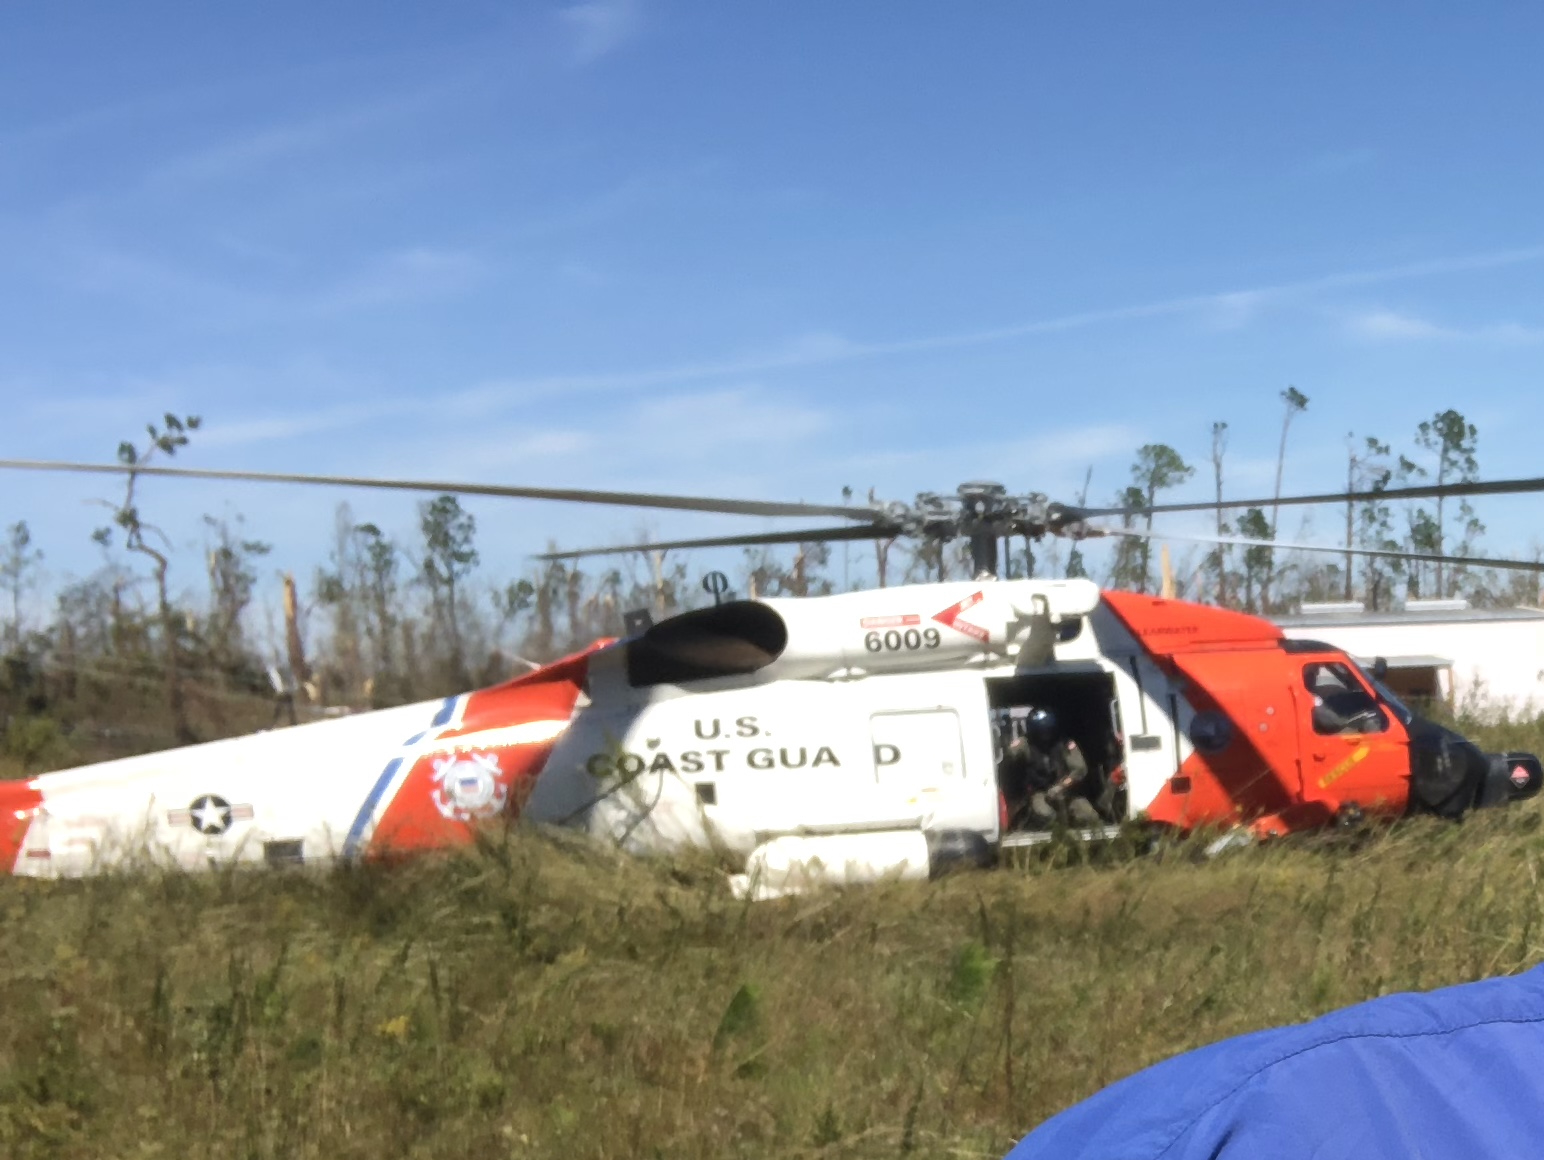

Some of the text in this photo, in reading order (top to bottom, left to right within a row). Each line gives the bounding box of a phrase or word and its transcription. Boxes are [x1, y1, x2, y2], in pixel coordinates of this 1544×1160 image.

[864, 627, 941, 653] 6009
[694, 715, 772, 740] U.S.
[587, 744, 901, 778] COAST GUAD
